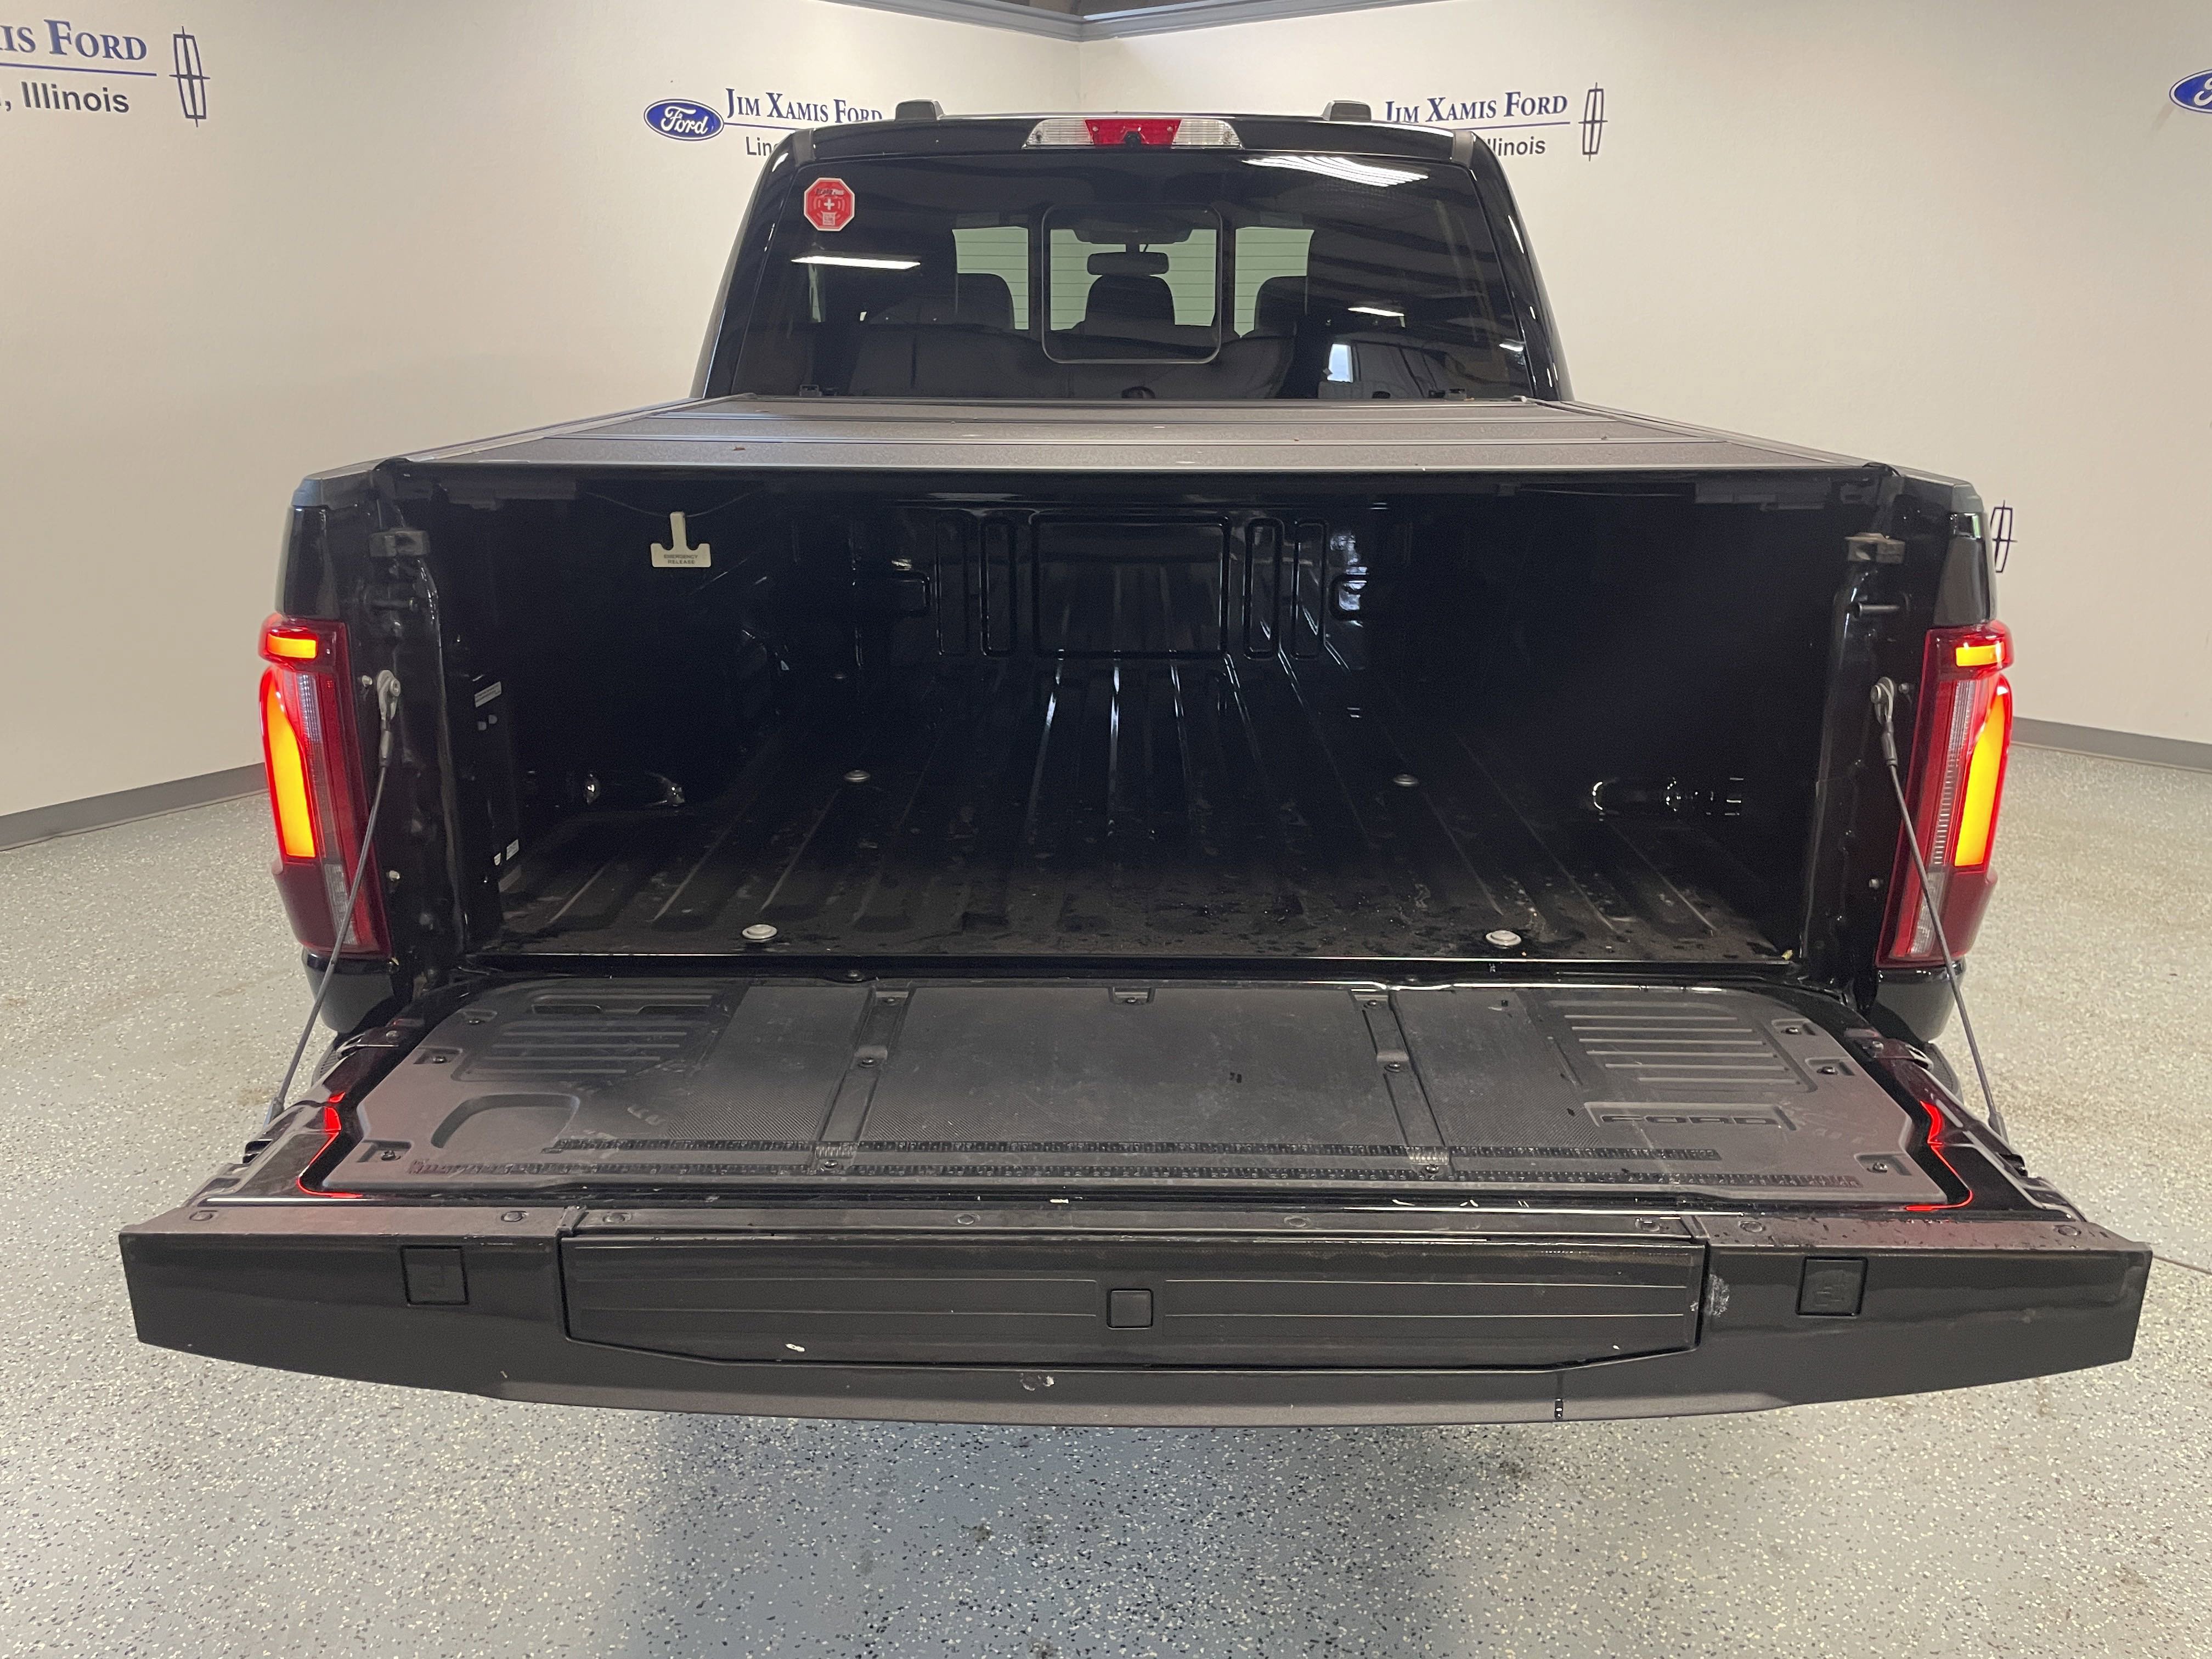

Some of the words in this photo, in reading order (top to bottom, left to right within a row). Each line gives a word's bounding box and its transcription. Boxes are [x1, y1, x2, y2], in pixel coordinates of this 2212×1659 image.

[0, 25, 36, 53] IS
[44, 19, 147, 60] FORD
[21, 81, 129, 112] Illinois
[725, 88, 761, 118] JIM
[765, 92, 829, 122] XAMIS
[1425, 97, 1497, 122] XAMIS
[1503, 91, 1568, 117] FORD
[661, 106, 709, 134] Ford
